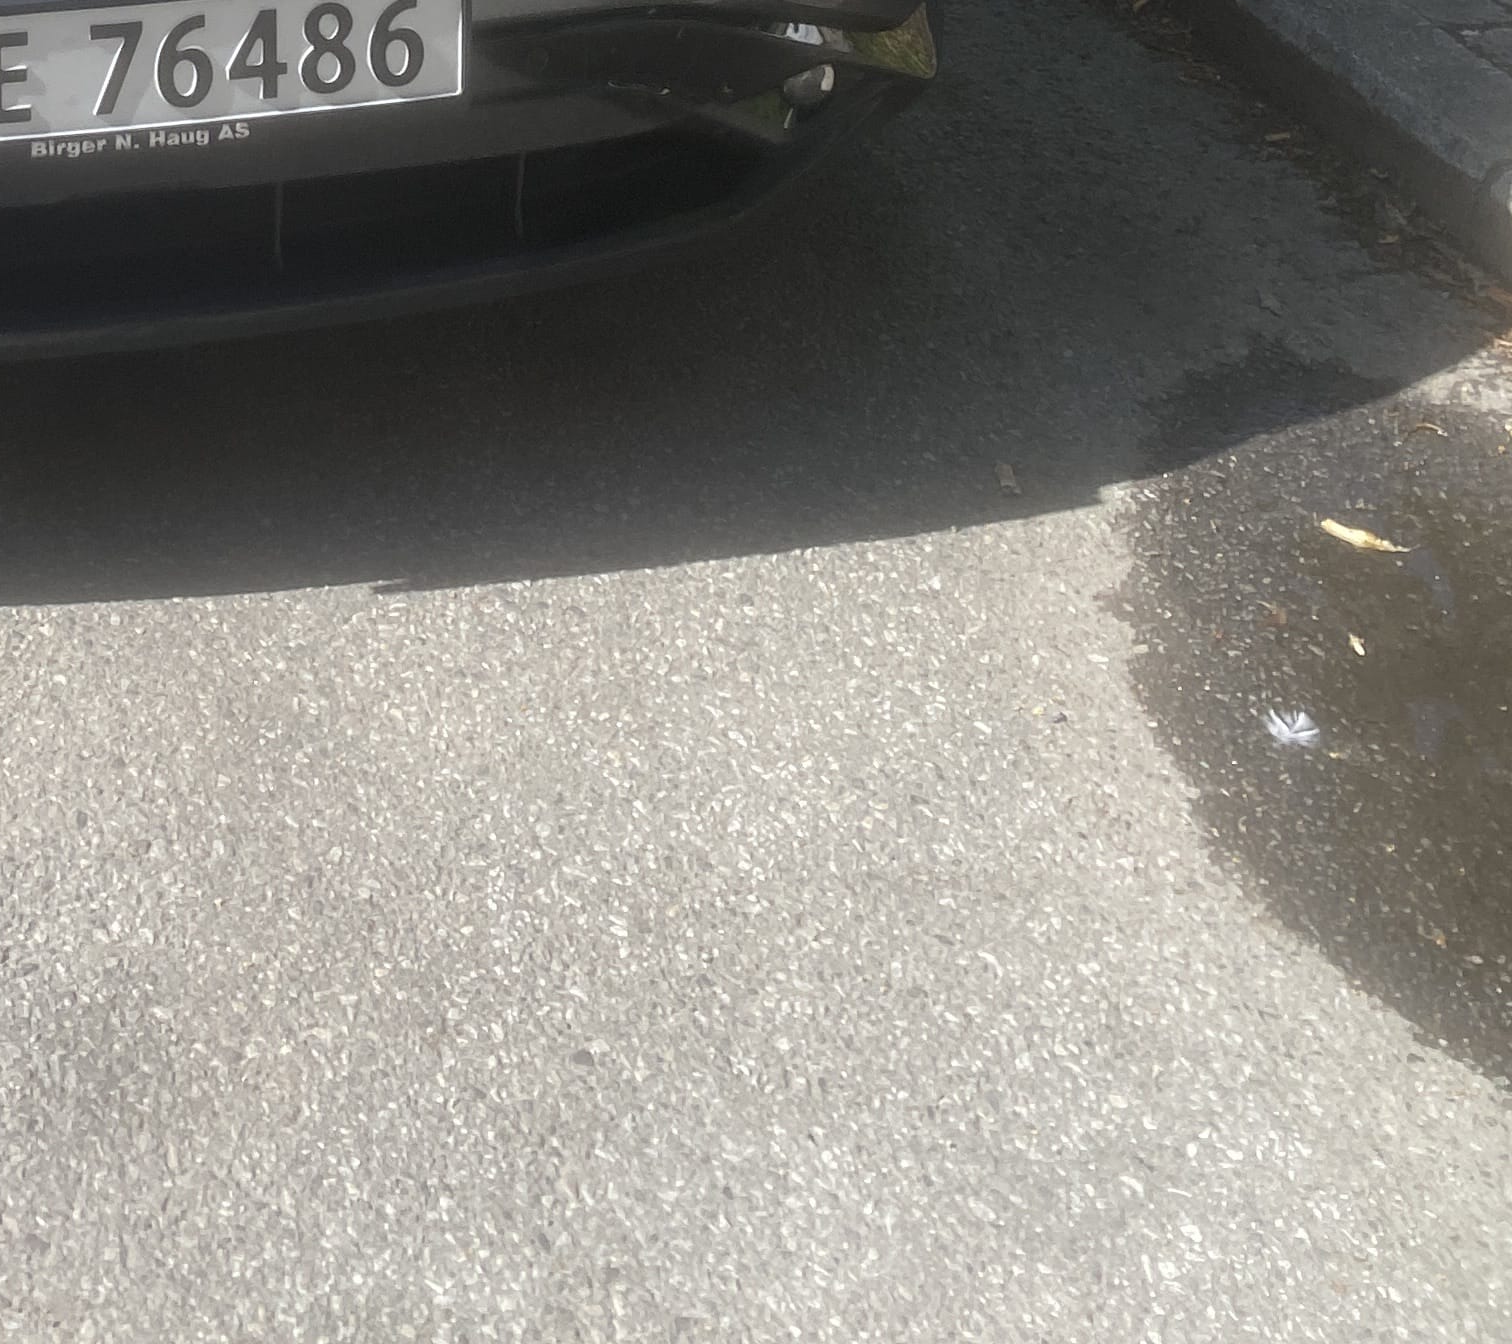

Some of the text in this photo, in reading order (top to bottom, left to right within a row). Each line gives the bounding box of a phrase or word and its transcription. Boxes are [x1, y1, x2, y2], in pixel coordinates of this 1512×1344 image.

[31, 122, 250, 158] Birger N. Haug AS
